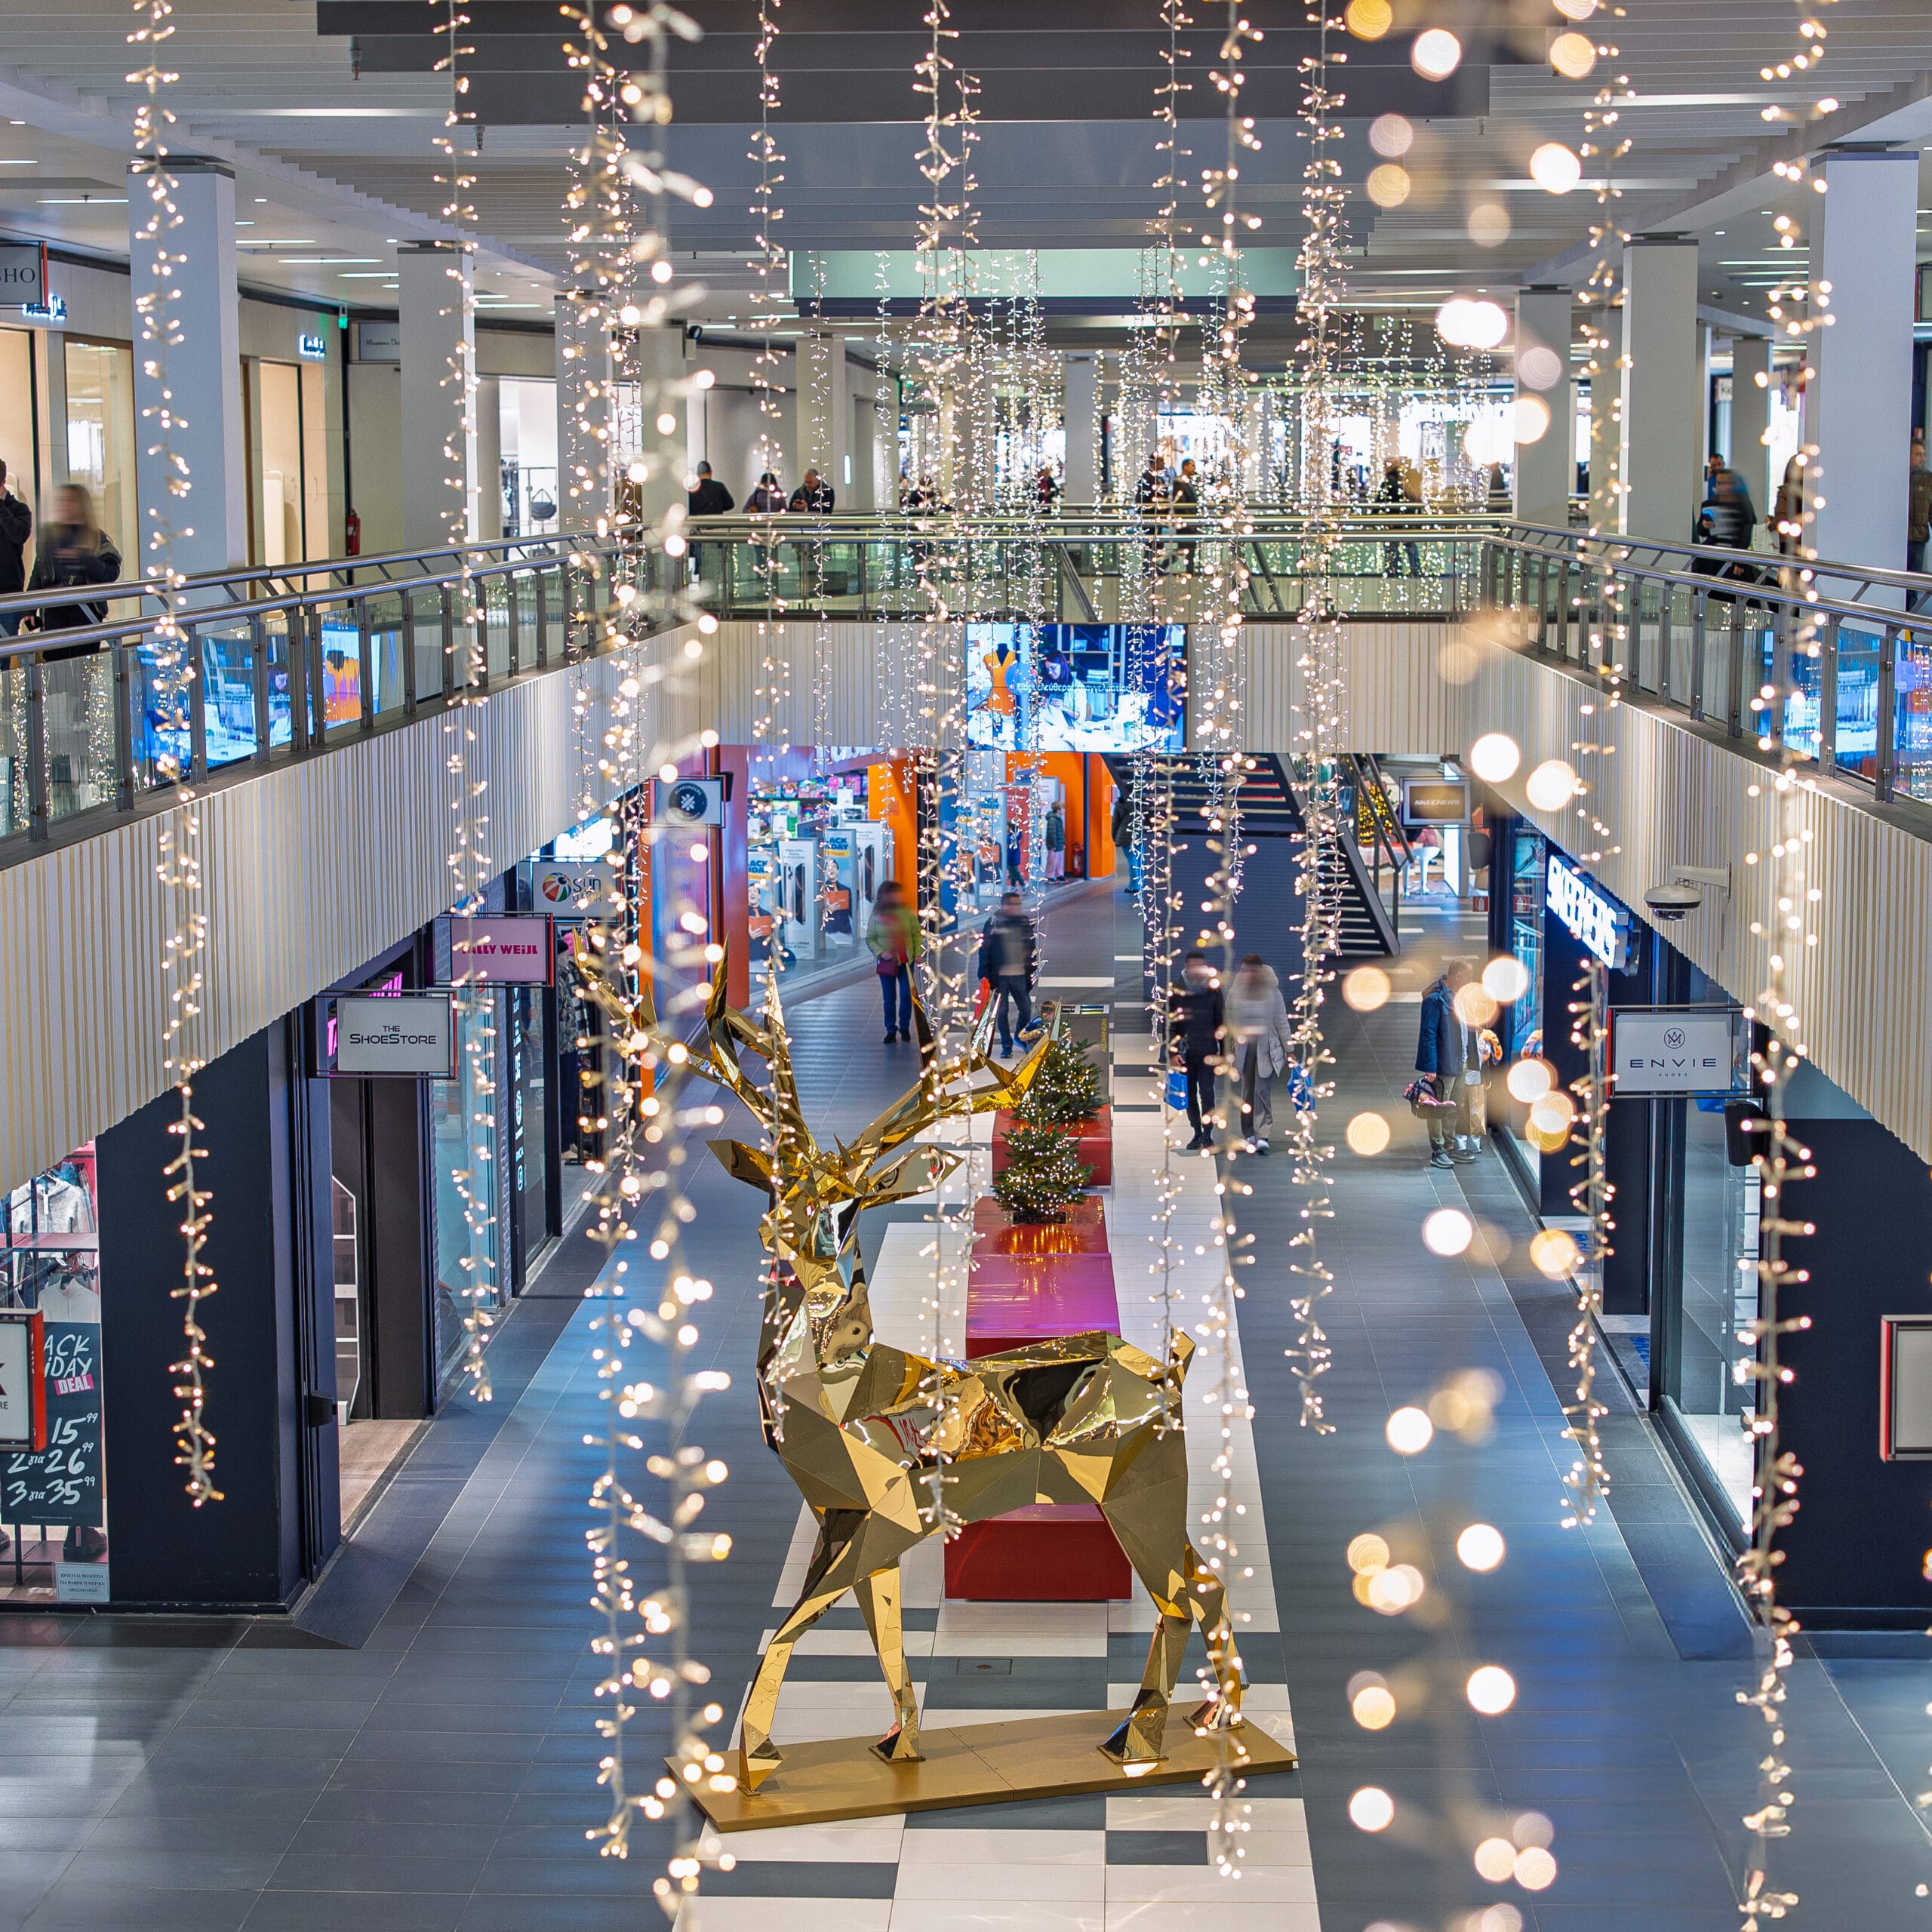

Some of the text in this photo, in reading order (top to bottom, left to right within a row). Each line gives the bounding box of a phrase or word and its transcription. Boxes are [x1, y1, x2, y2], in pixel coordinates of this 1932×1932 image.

[0, 267, 35, 284] HO
[1629, 1058, 1717, 1069] ENVIE
[57, 1375, 91, 1395] DEAL
[7, 1480, 28, 1507] 3
